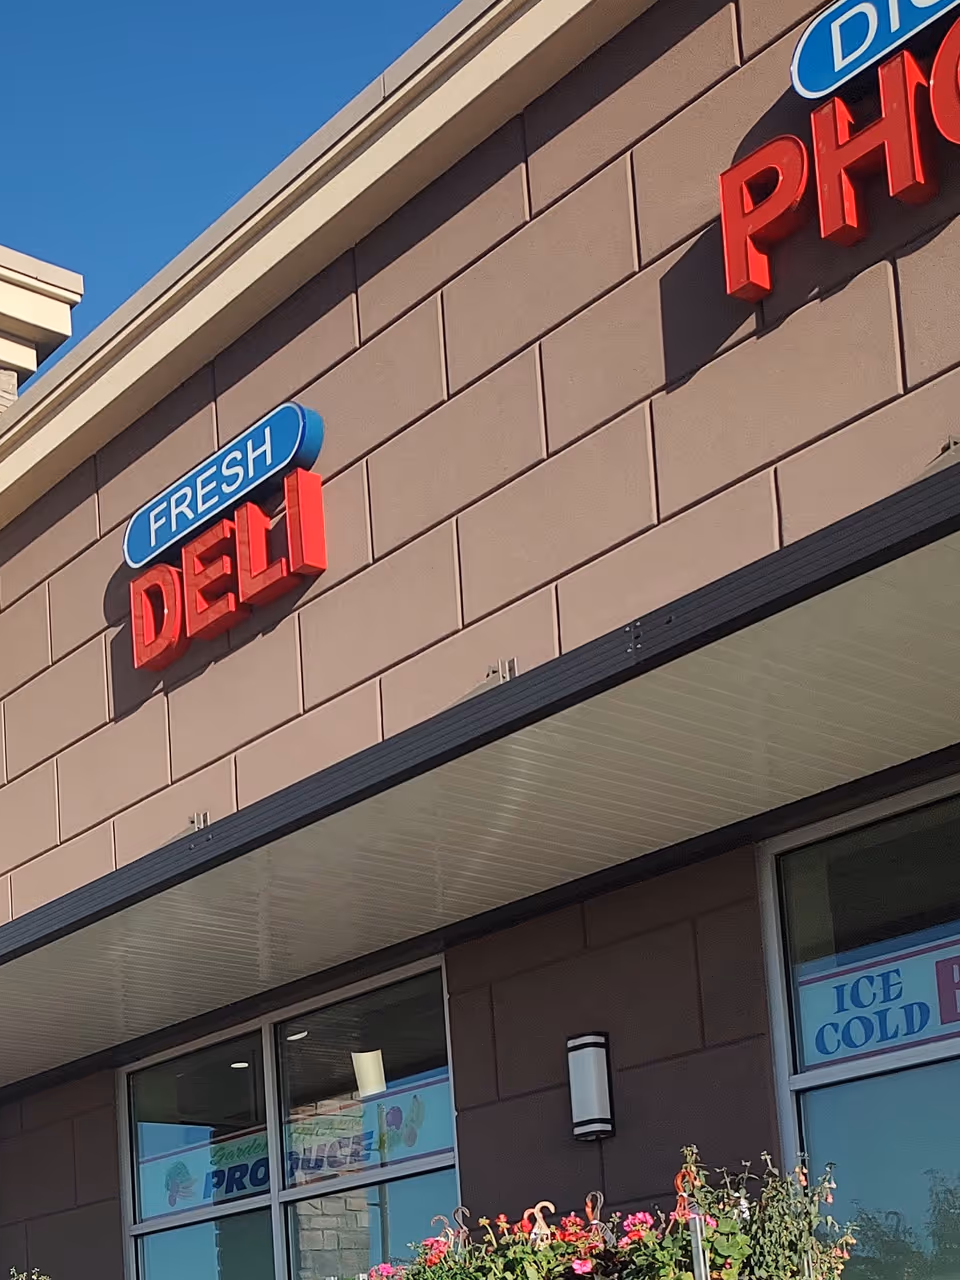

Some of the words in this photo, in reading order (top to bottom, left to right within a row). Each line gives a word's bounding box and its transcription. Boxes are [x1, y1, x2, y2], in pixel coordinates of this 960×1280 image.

[720, 16, 960, 298] PH
[148, 425, 273, 548] FRESH
[129, 467, 328, 671] DELI
[814, 1001, 931, 1056] COLD
[832, 967, 904, 1015] ICE
